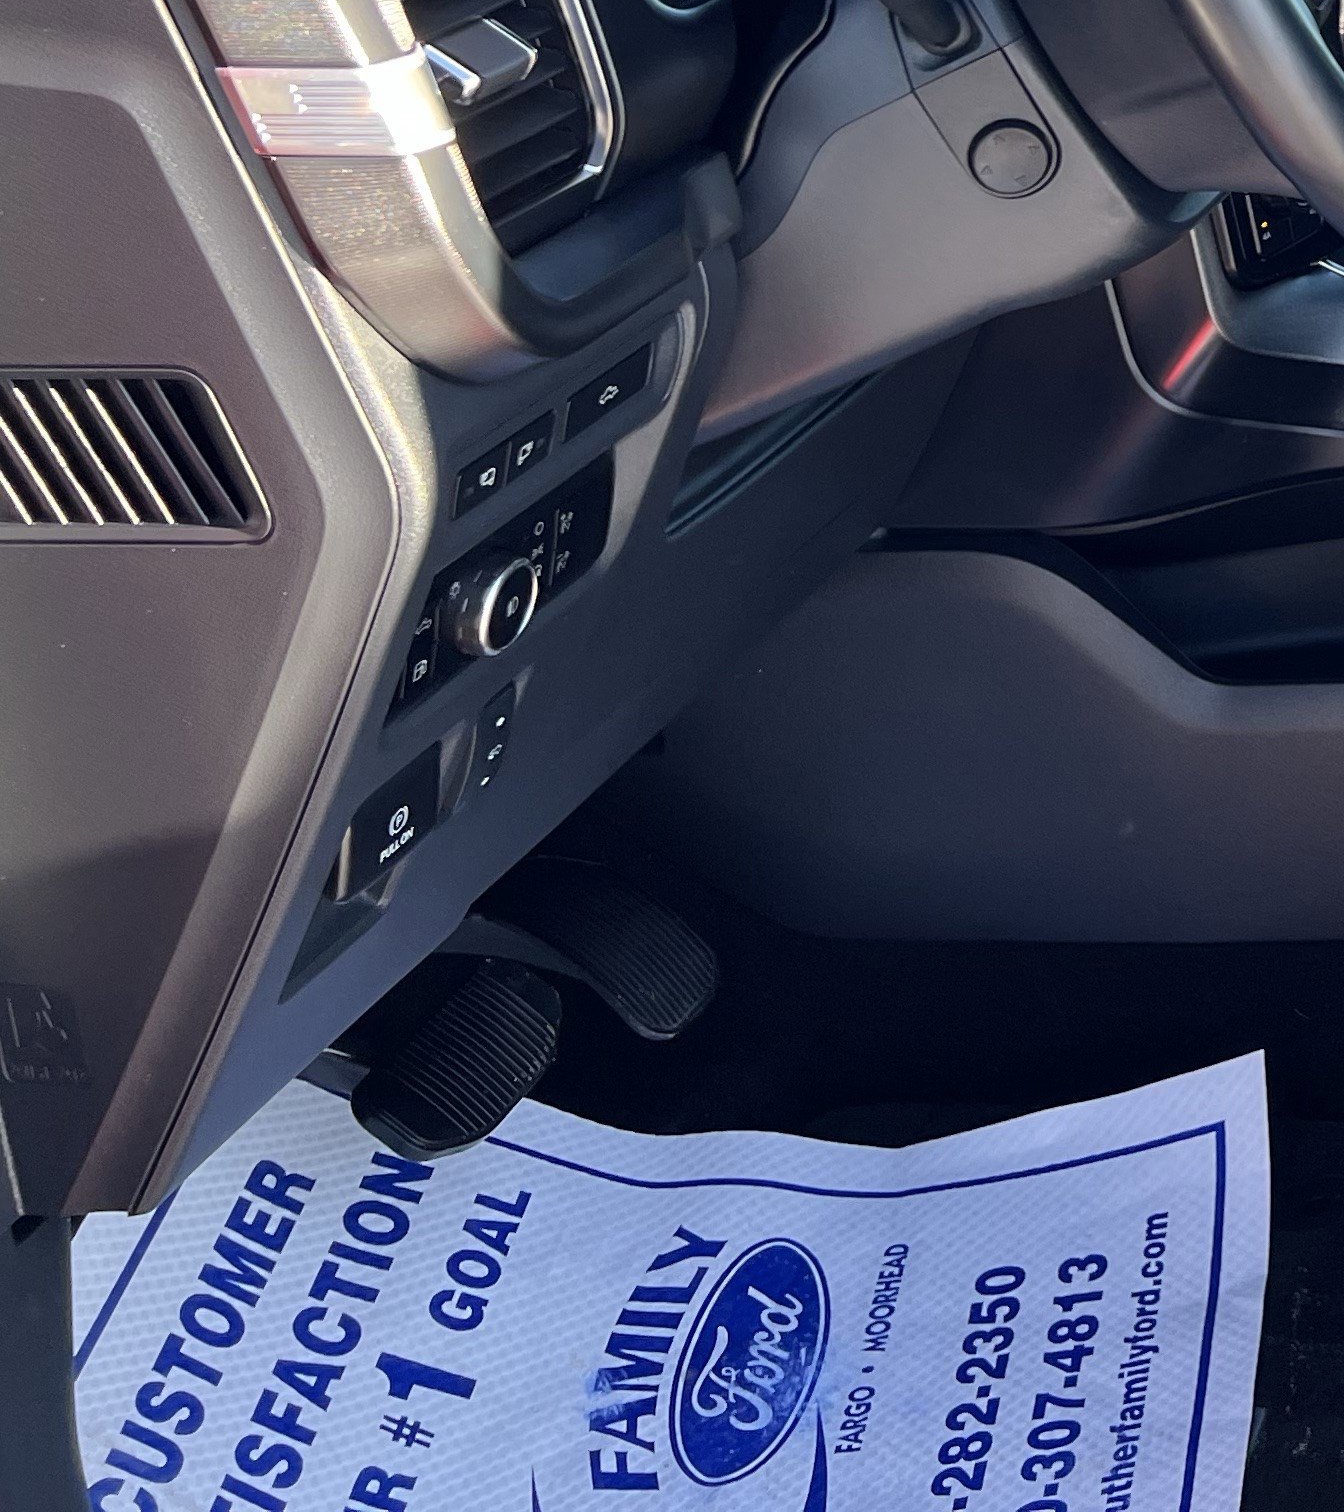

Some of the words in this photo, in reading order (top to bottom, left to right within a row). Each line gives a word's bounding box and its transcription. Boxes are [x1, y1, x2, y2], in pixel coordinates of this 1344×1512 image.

[380, 840, 400, 863] PULL
[400, 827, 414, 844] ON
[87, 1159, 316, 1512] CUSTOMER
[343, 1465, 418, 1512] R
[429, 1190, 532, 1331] GOAL
[588, 1225, 728, 1490] FAMILY
[691, 1285, 803, 1431] Ford
[834, 1386, 876, 1455] FARGO
[862, 1243, 909, 1352] MOORHEAD
[1101, 1212, 1169, 1512] utherfamilyford.com
